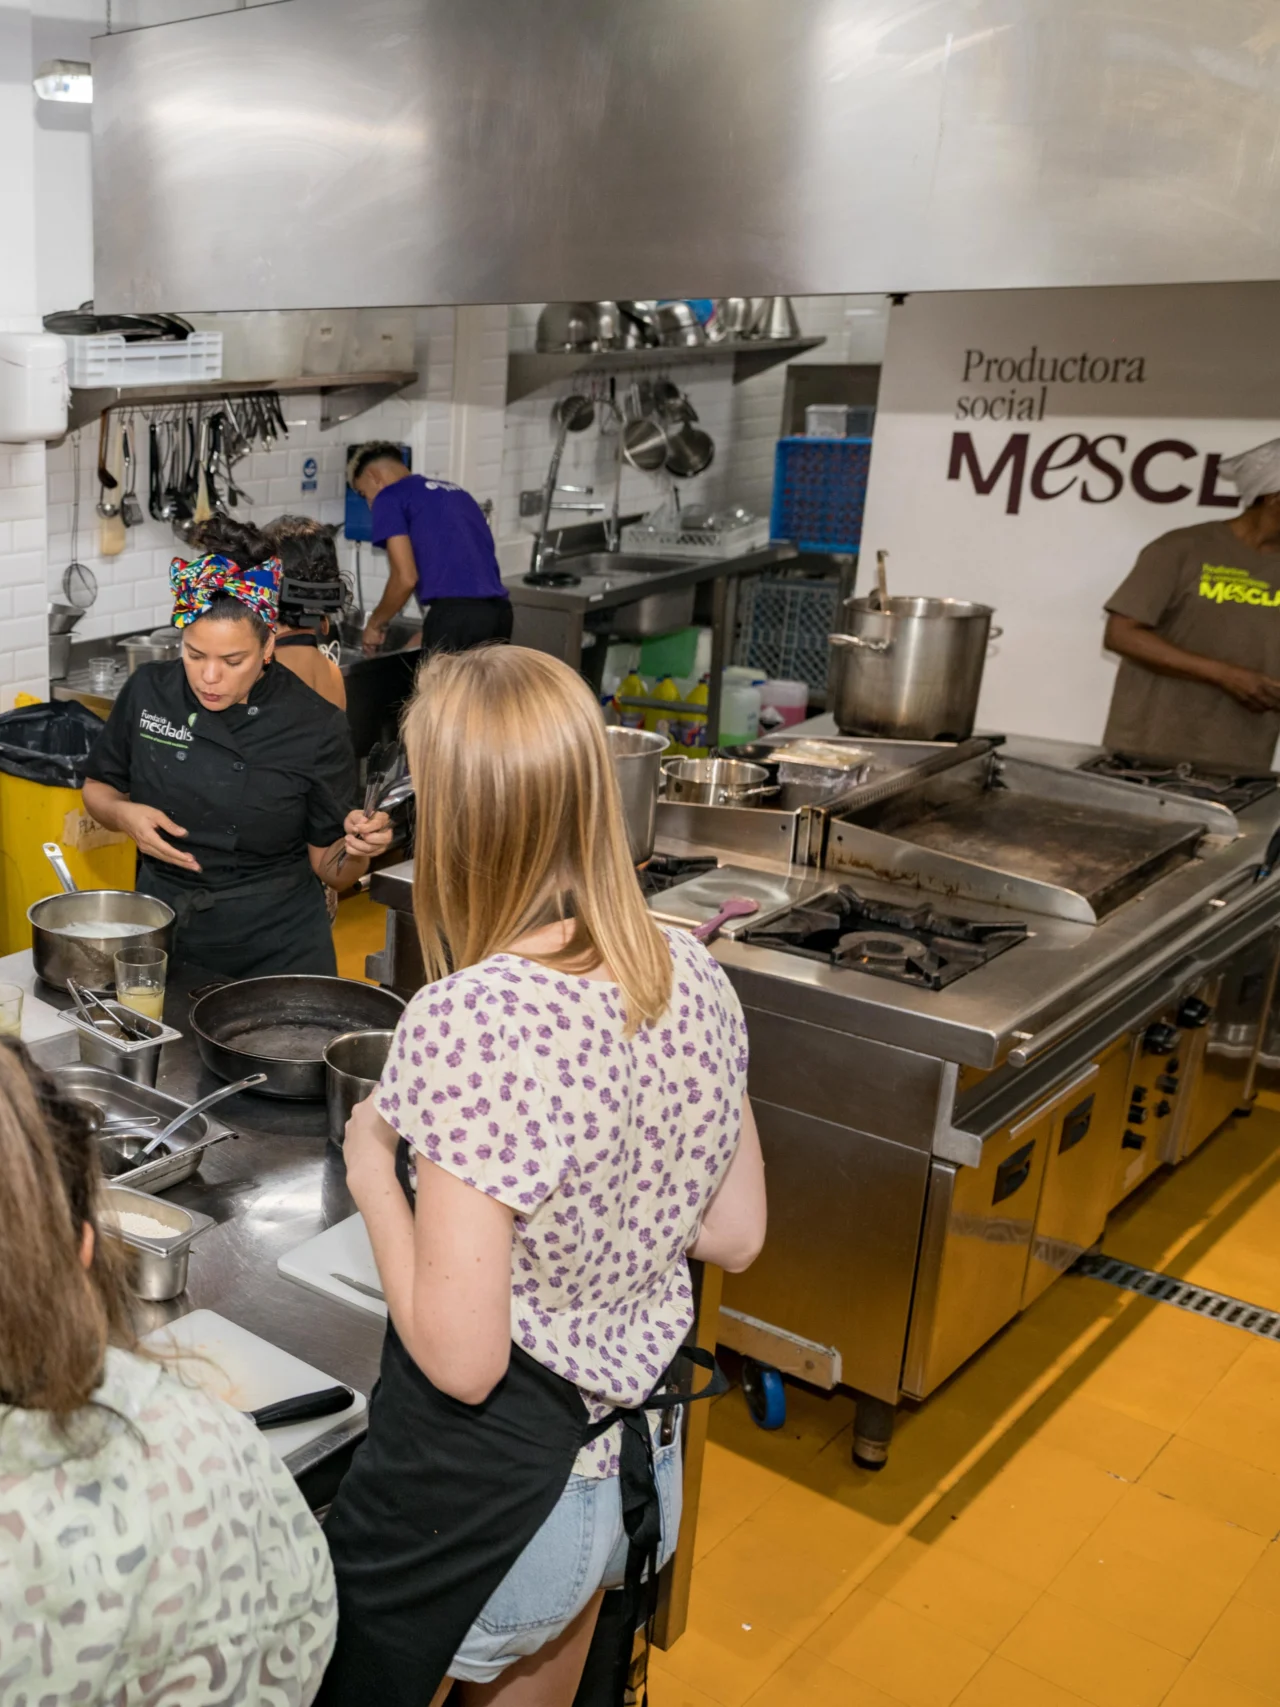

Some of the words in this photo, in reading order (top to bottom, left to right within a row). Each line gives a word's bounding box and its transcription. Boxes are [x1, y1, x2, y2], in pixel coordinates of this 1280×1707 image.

[961, 346, 1147, 384] Productora
[955, 386, 1049, 421] social
[139, 718, 194, 742] mescladis
